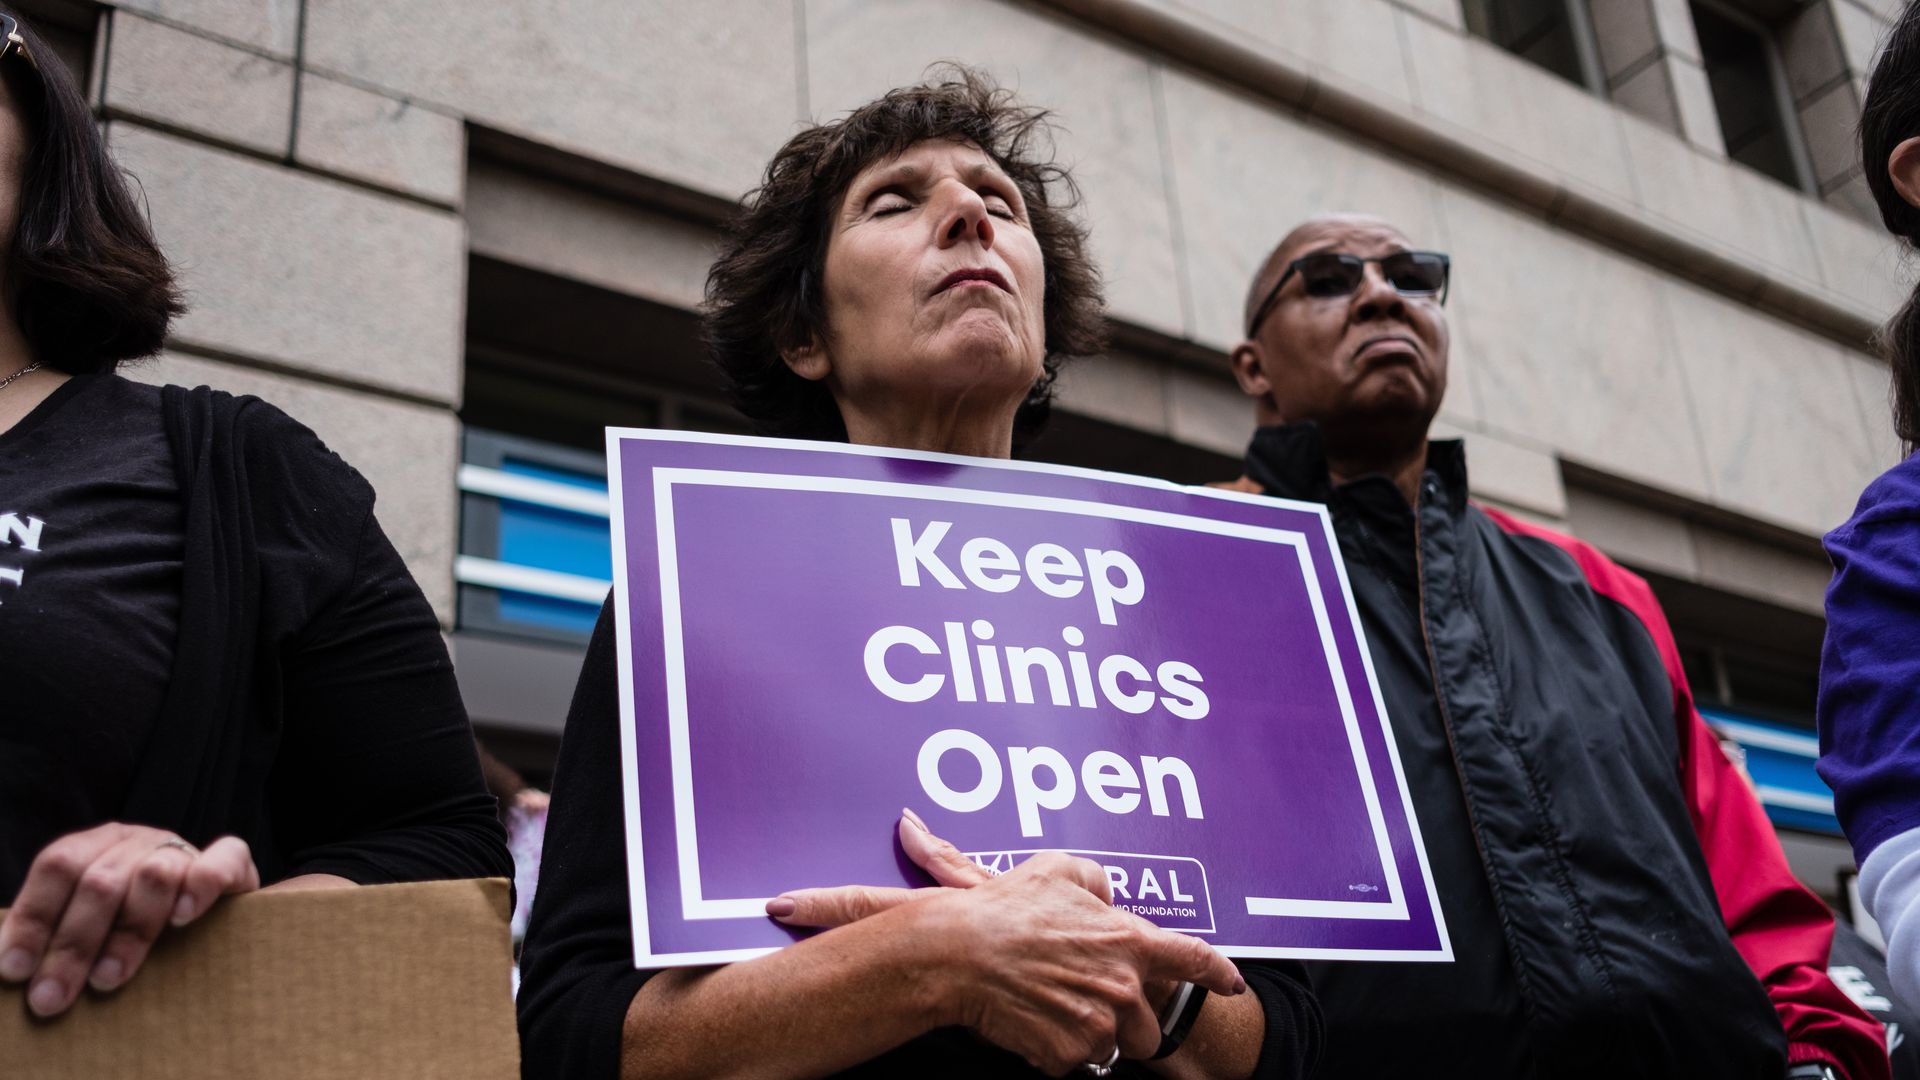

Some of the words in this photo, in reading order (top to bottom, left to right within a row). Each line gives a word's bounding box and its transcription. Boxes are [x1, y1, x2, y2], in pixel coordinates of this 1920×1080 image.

[890, 518, 1145, 626] Keep
[864, 619, 1210, 720] Clinics
[917, 729, 1204, 838] Open
[1132, 905, 1197, 917] FOUNDATION
